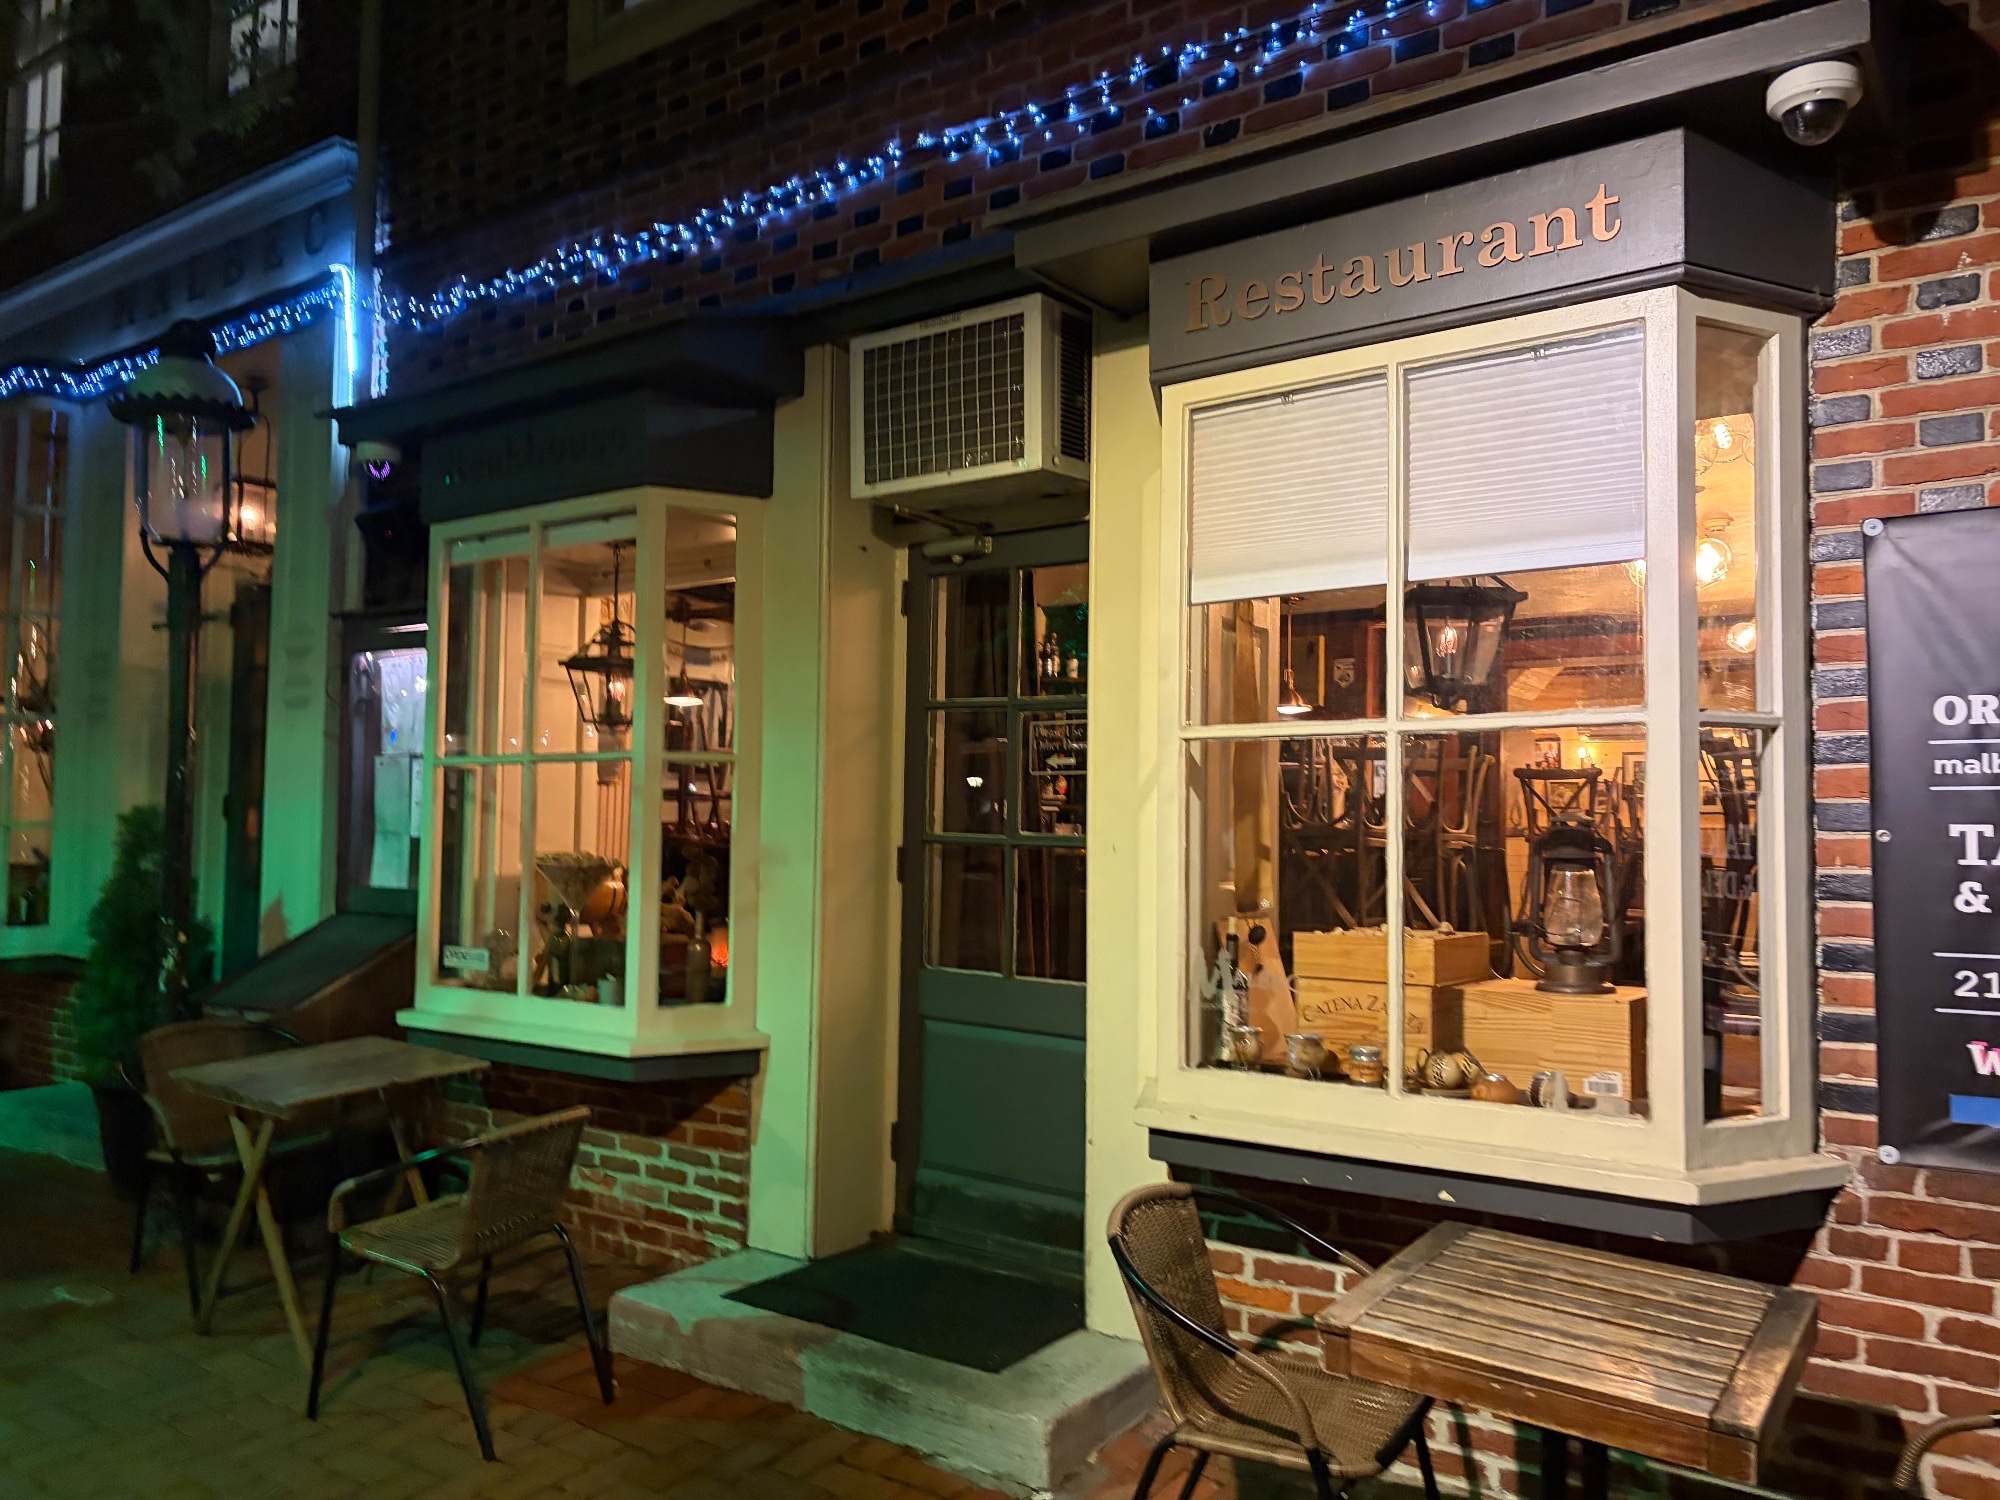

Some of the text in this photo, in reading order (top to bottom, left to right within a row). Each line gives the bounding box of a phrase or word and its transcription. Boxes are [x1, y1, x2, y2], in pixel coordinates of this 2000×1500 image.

[1183, 183, 1622, 334] Restaurant
[1933, 694, 2000, 726] OR
[1948, 823, 2000, 866] T
[1954, 880, 1992, 914] &
